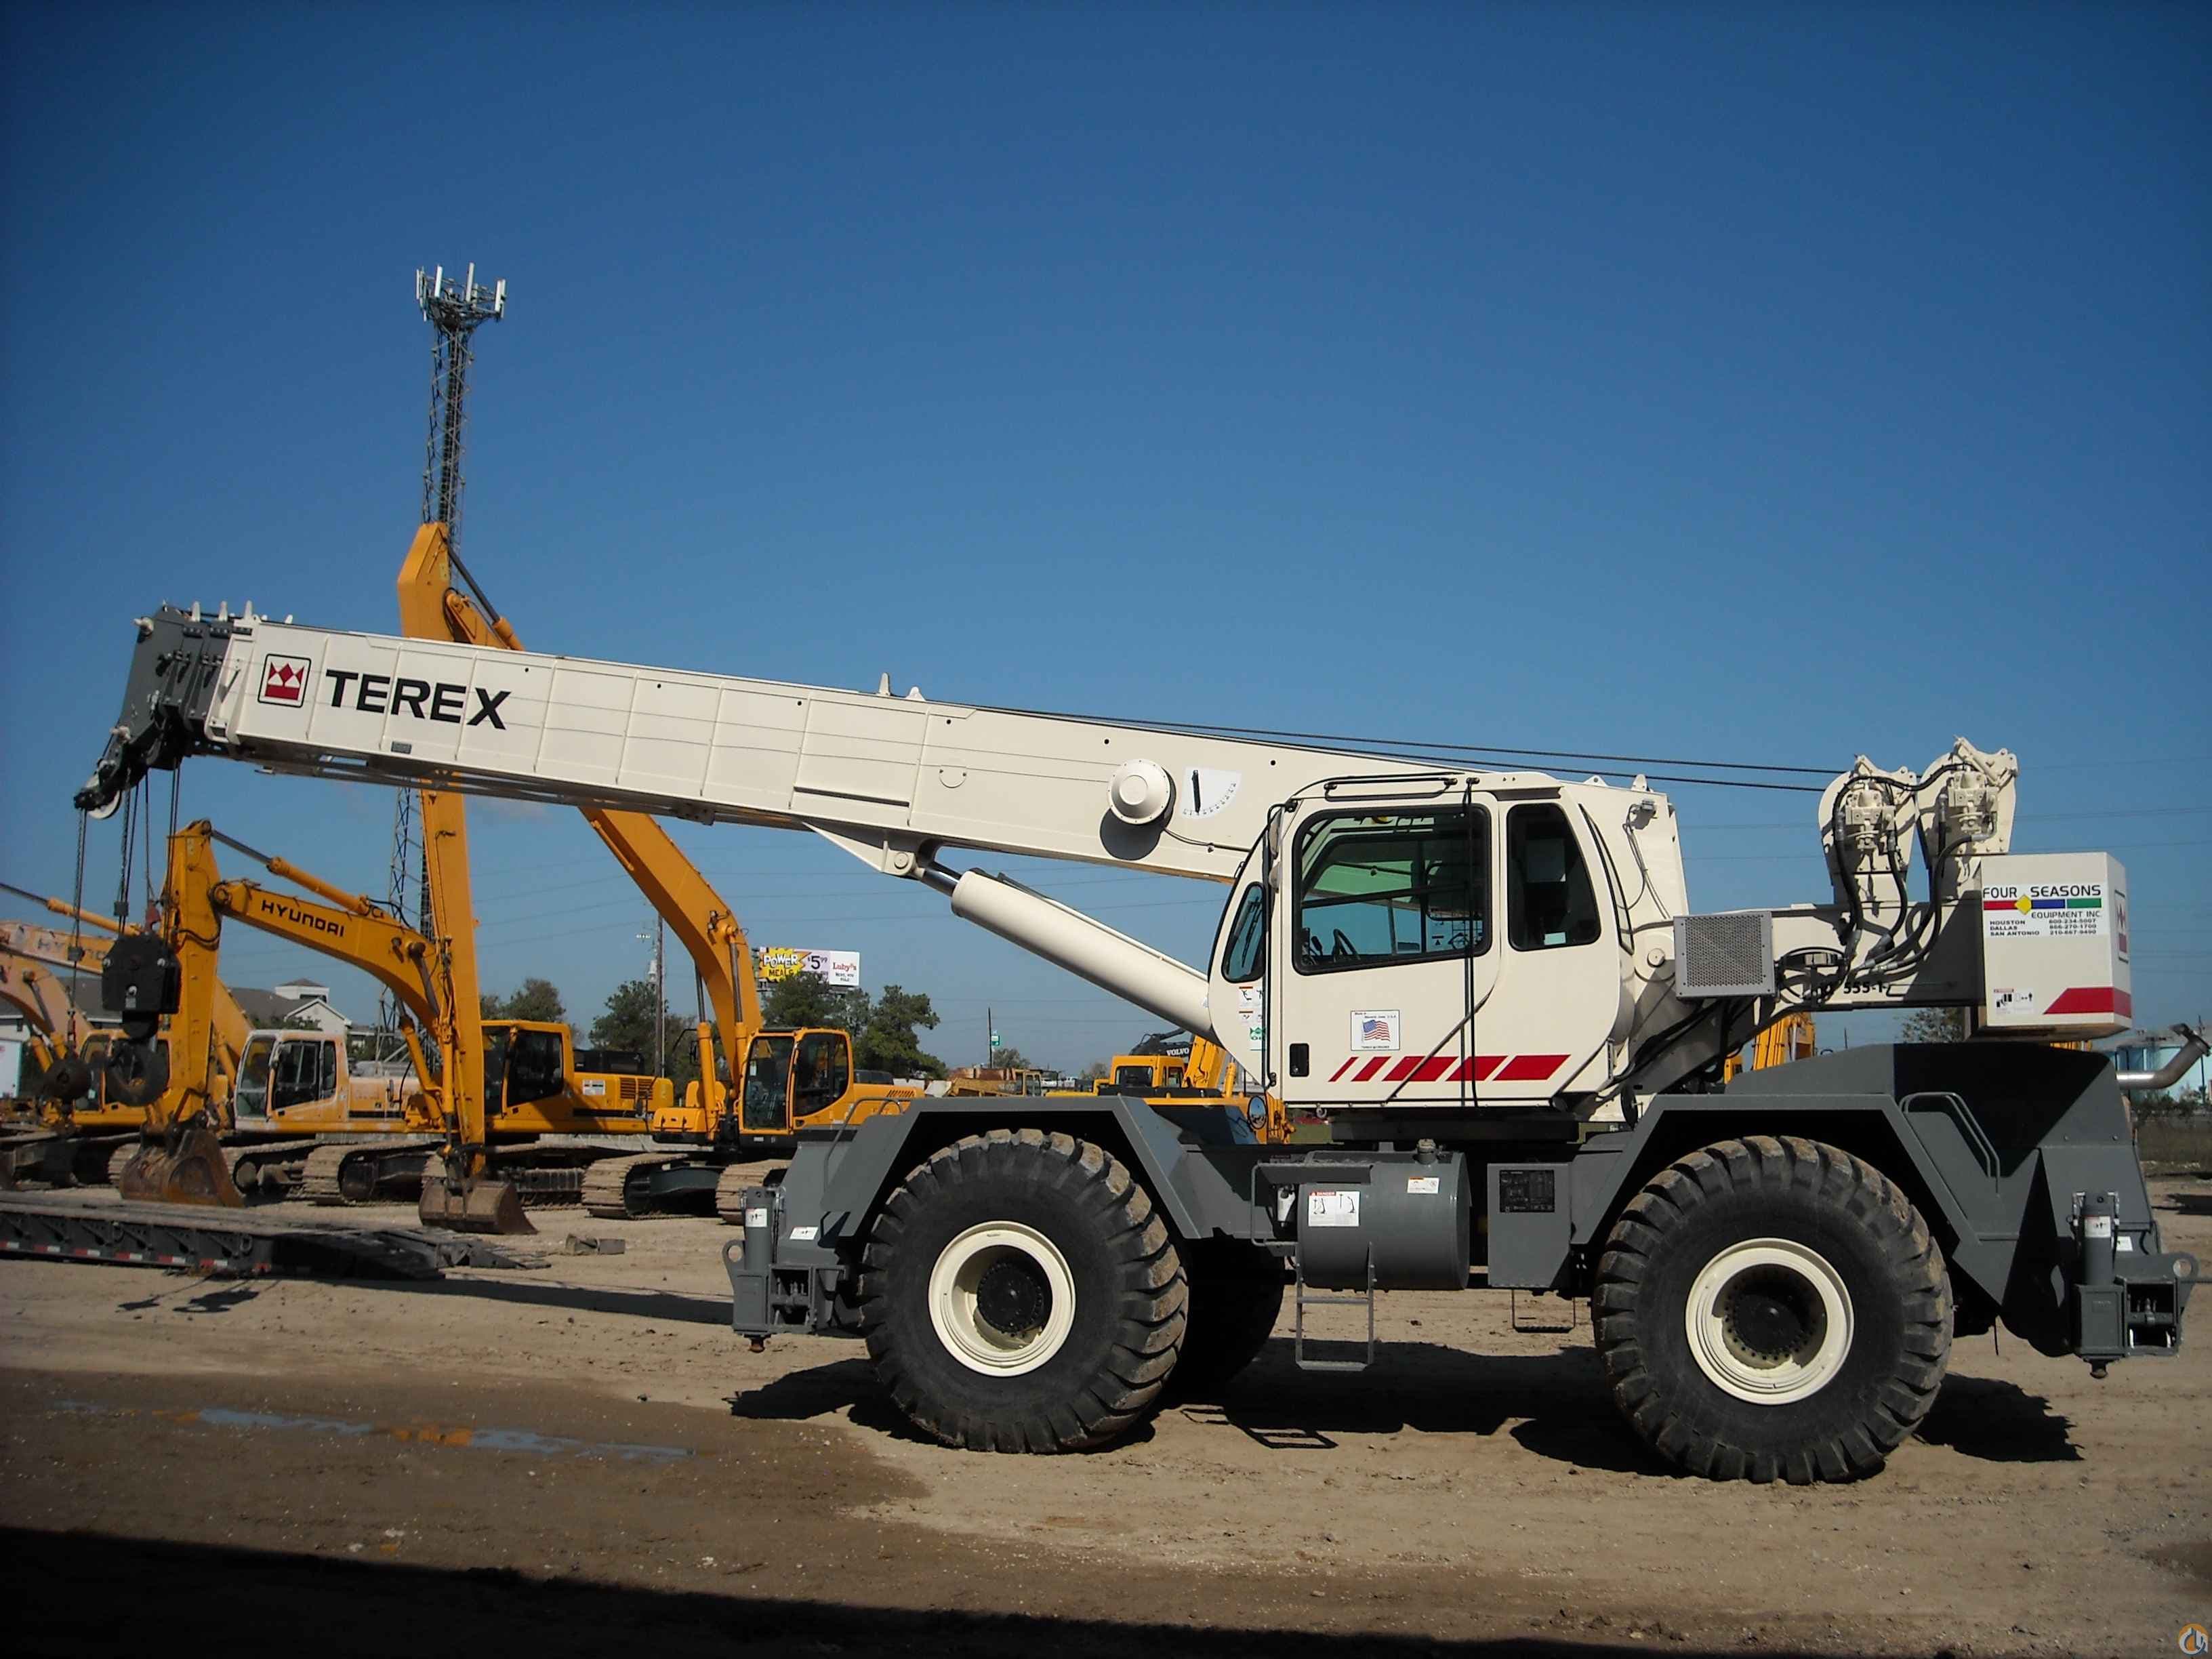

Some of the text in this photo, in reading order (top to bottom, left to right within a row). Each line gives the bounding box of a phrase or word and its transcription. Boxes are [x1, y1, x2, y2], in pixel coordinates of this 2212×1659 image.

[326, 669, 512, 730] TEREX
[1983, 884, 2101, 898] FOUR SEASONS
[262, 900, 344, 937] HYUNDAI
[763, 954, 798, 968] POWER
[833, 962, 857, 972] Luby's
[1166, 1047, 1190, 1057] VOLVO
